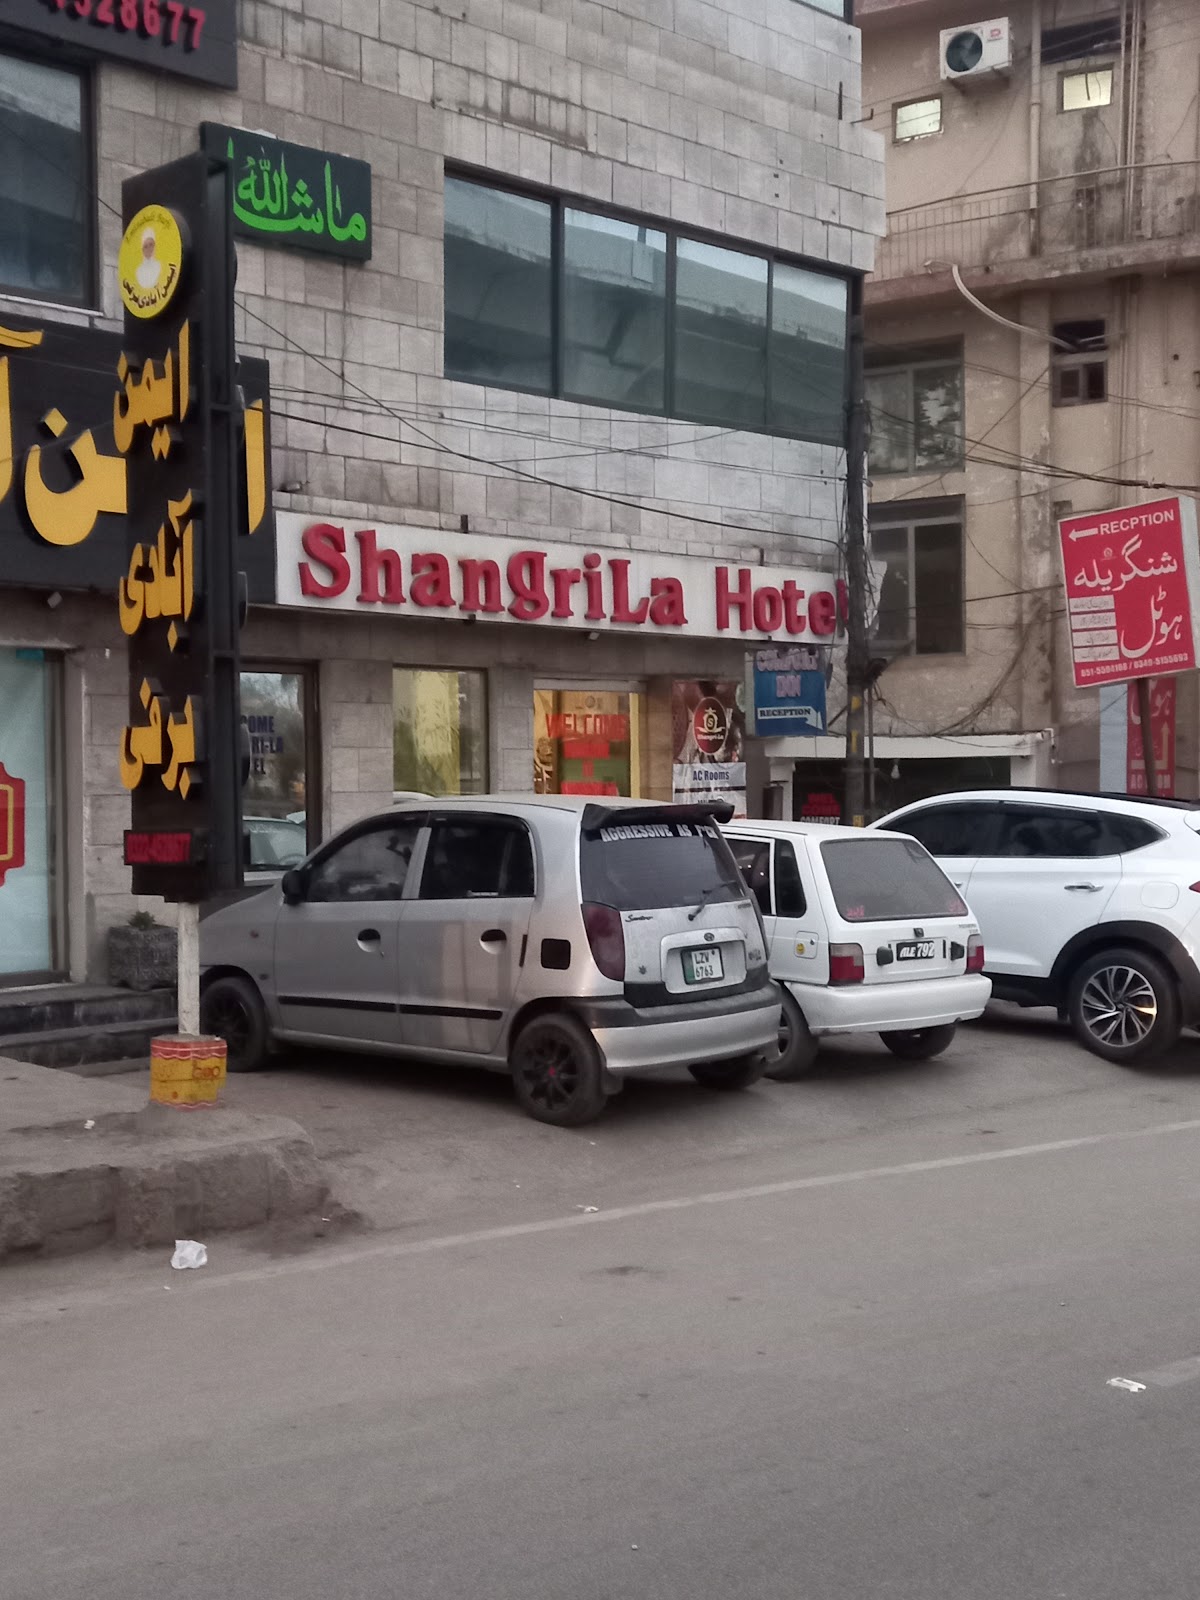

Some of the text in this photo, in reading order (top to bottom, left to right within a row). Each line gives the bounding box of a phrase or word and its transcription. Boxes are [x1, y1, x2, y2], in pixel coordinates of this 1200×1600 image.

[1100, 509, 1174, 535] RECPTION
[298, 523, 849, 636] ShangriLa Hotel
[760, 708, 811, 718] RECEPTION
[118, 677, 196, 801] برفی
[692, 770, 730, 781] AC Rooms
[600, 824, 673, 842] AGGRESSIVE
[676, 824, 693, 837] AS
[917, 942, 935, 958] 792
[695, 965, 714, 978] 6763
